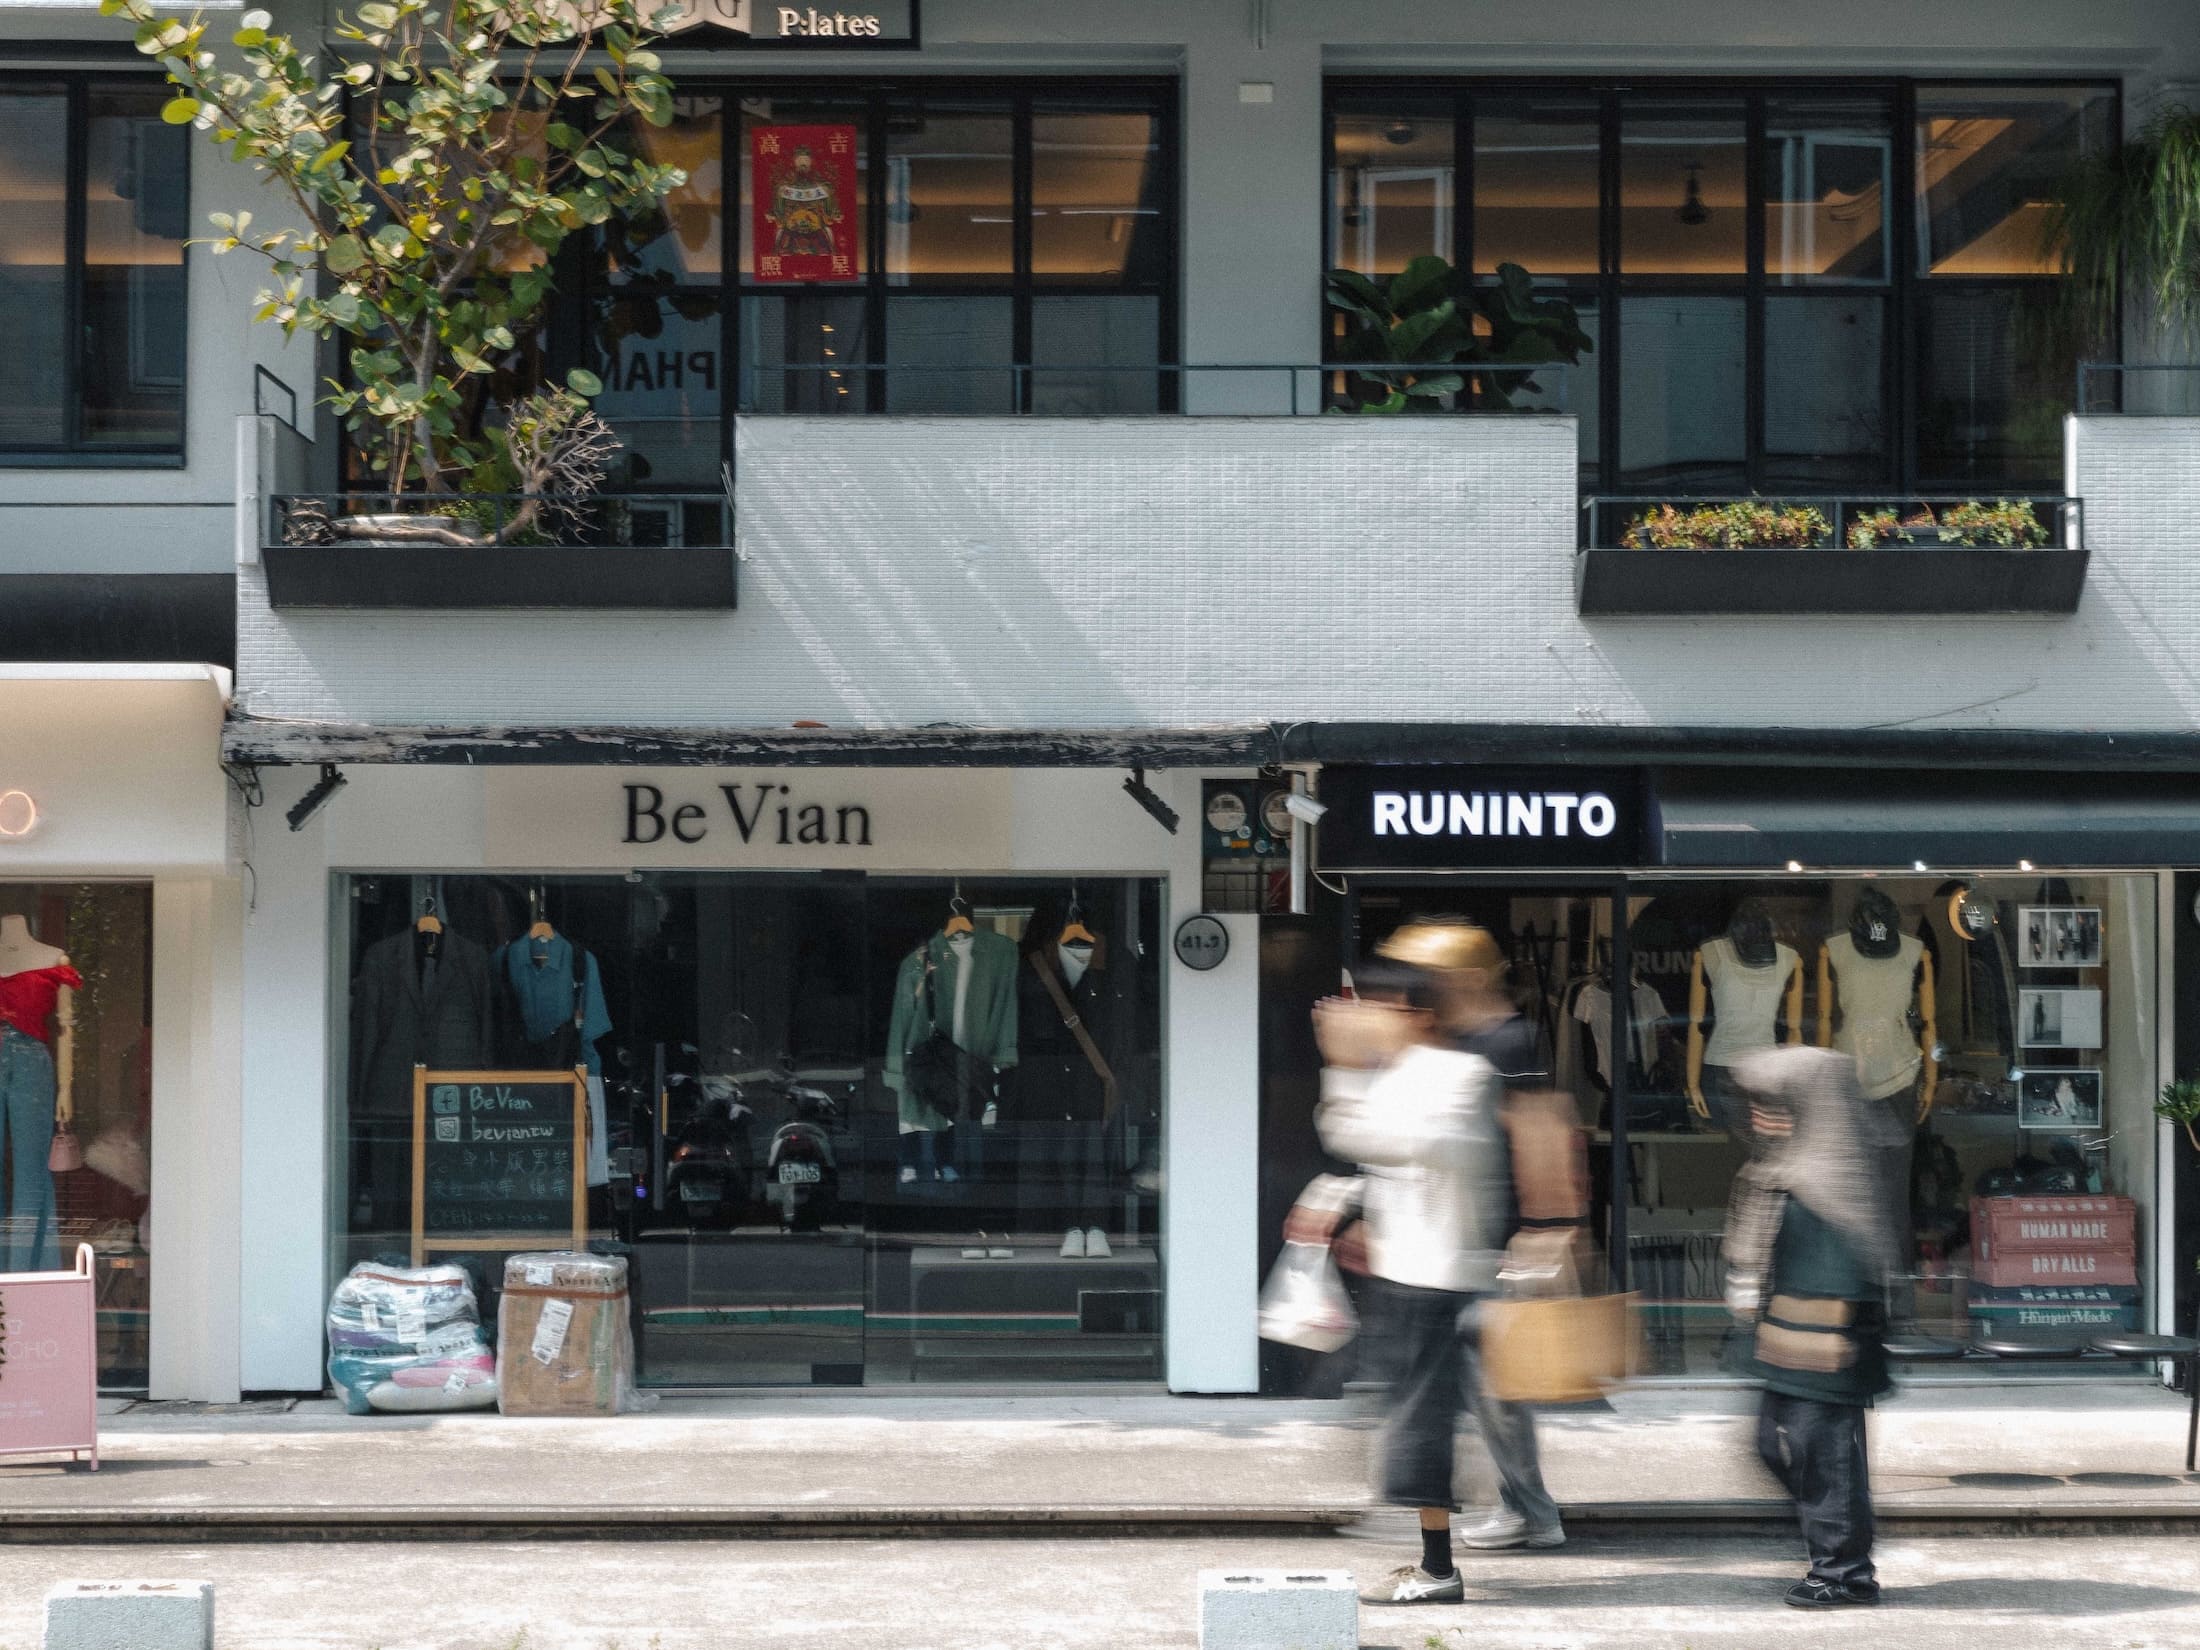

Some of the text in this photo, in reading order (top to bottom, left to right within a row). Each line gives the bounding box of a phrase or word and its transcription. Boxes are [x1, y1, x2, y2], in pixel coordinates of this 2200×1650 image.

[830, 133, 850, 154] 吉
[621, 784, 873, 846] Be Vian
[1373, 791, 1617, 837] RUNINTO
[2021, 1222, 2108, 1239] HUMAN MADE
[2032, 1256, 2096, 1273] DRY ALLS
